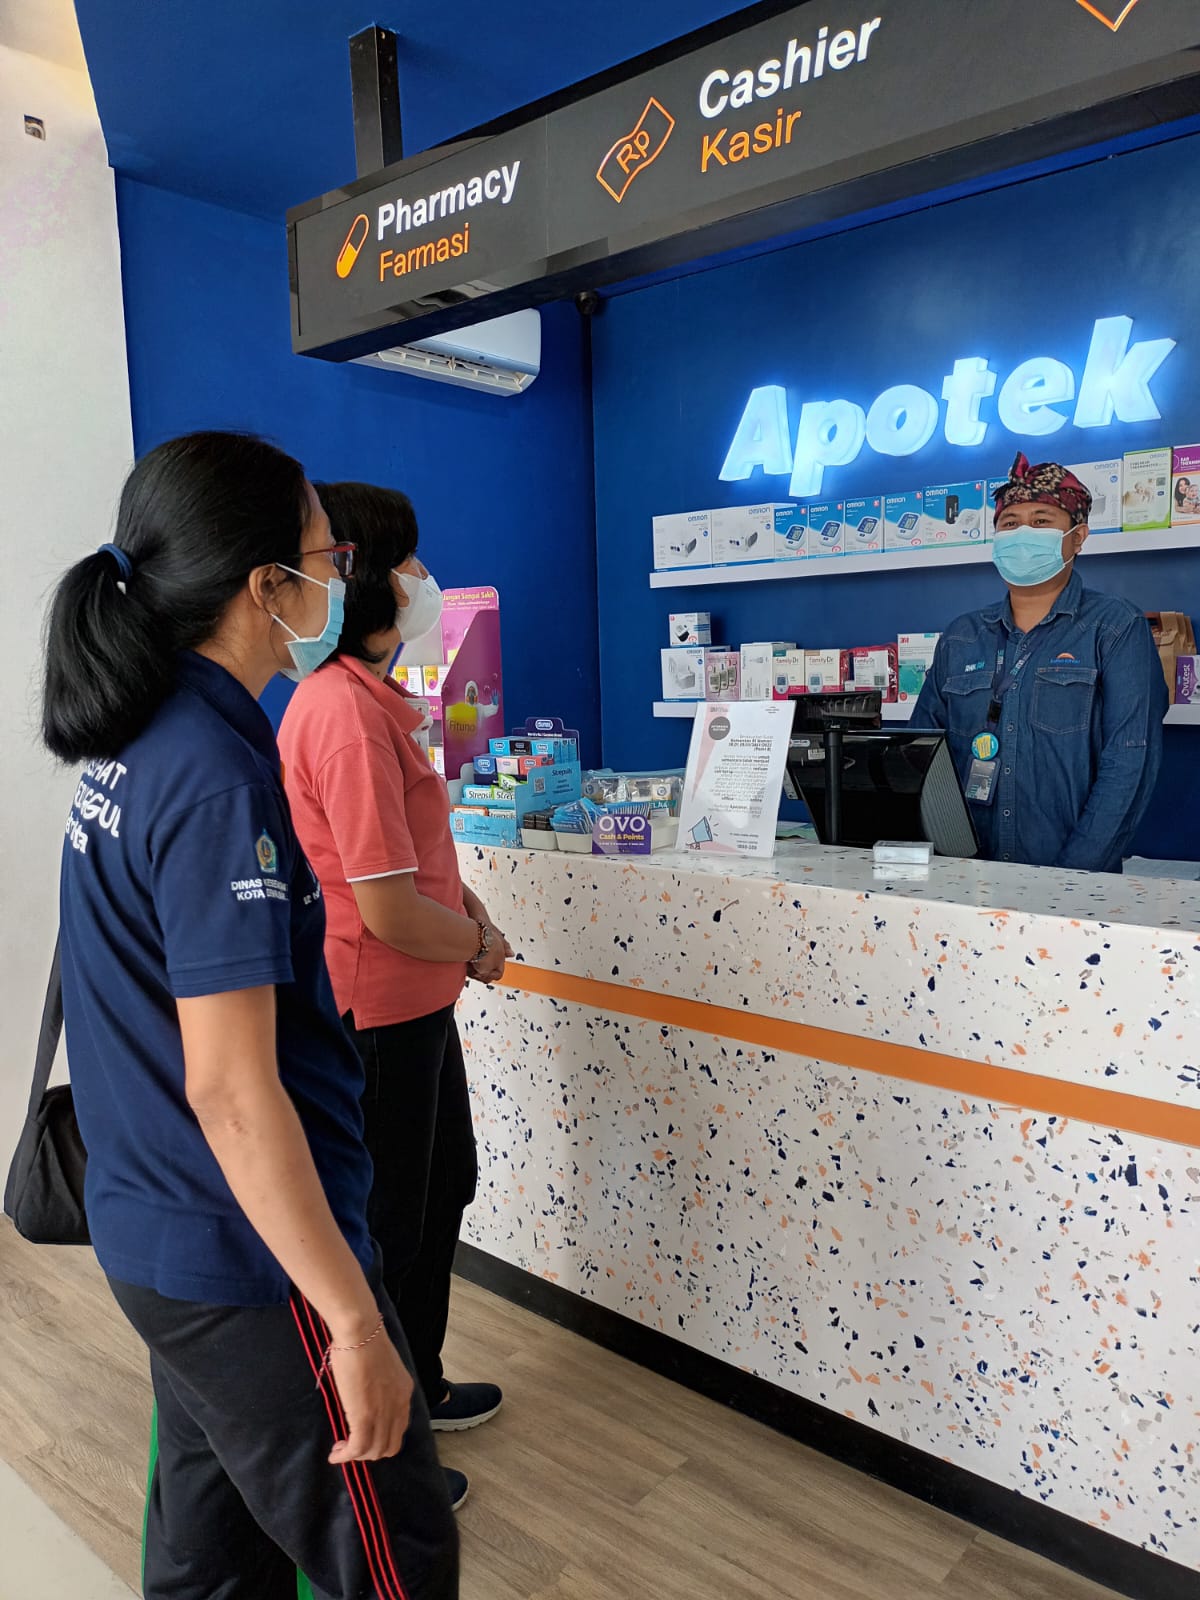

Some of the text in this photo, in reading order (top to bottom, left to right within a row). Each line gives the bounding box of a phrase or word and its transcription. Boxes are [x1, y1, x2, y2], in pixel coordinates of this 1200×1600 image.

[699, 17, 881, 119] Cashier
[700, 107, 802, 173] Kasir
[377, 161, 520, 241] Pharmacy
[379, 223, 470, 282] Farmasi
[718, 315, 1177, 497] Apotek
[1181, 664, 1191, 697] Ovutest
[449, 720, 476, 733] Fituno
[599, 816, 646, 832] OVO
[623, 833, 645, 841] Points
[230, 878, 263, 891] DINAS
[236, 888, 266, 901] KOTA
